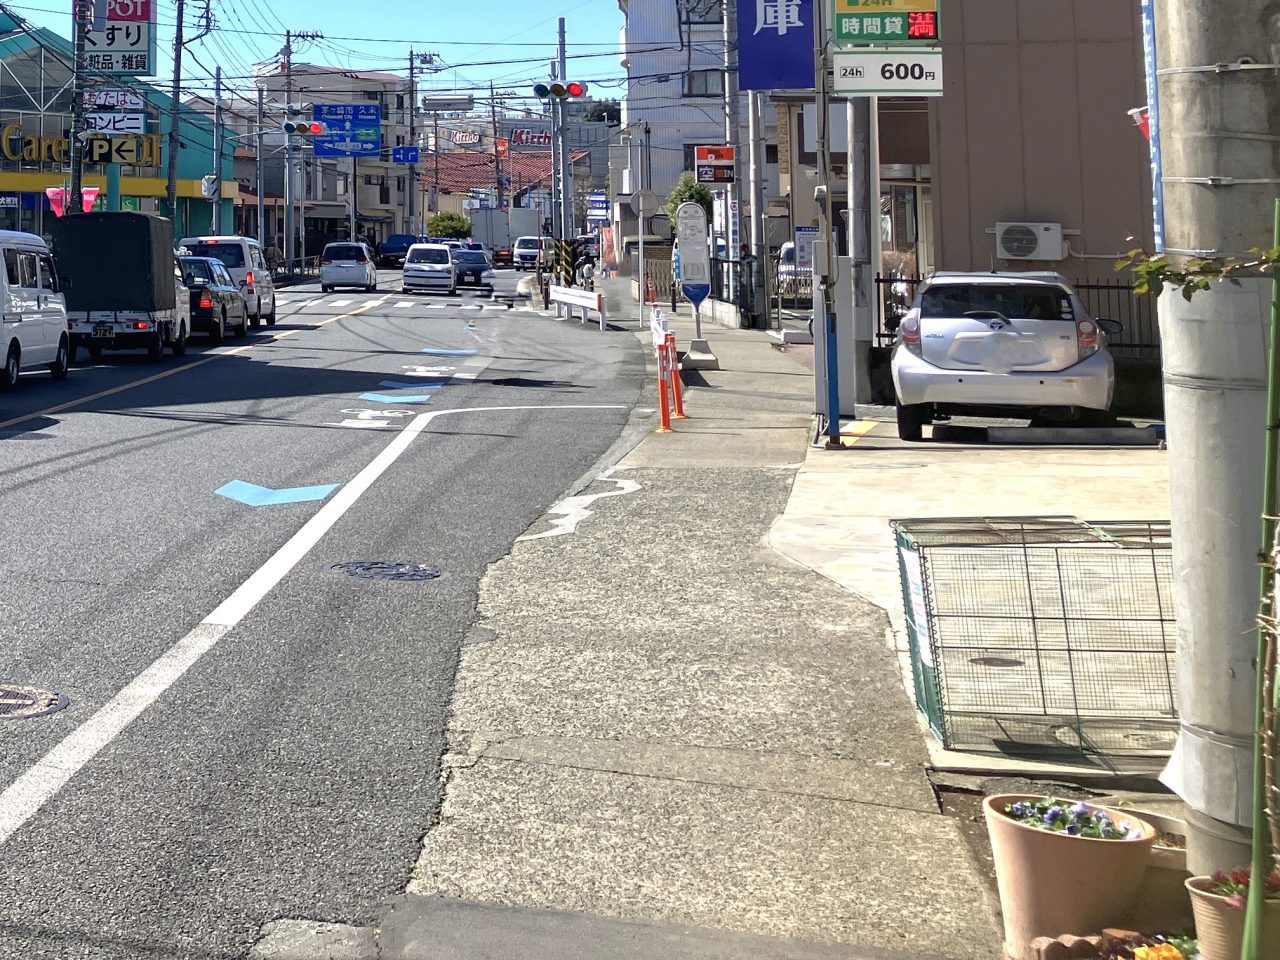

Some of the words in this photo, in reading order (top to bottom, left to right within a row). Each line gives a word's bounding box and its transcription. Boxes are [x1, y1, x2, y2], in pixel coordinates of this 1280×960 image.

[841, 16, 903, 35] 時間貸
[908, 12, 935, 36] 満
[841, 68, 862, 77] 24h
[0, 123, 71, 162] Care
[93, 139, 109, 161] P
